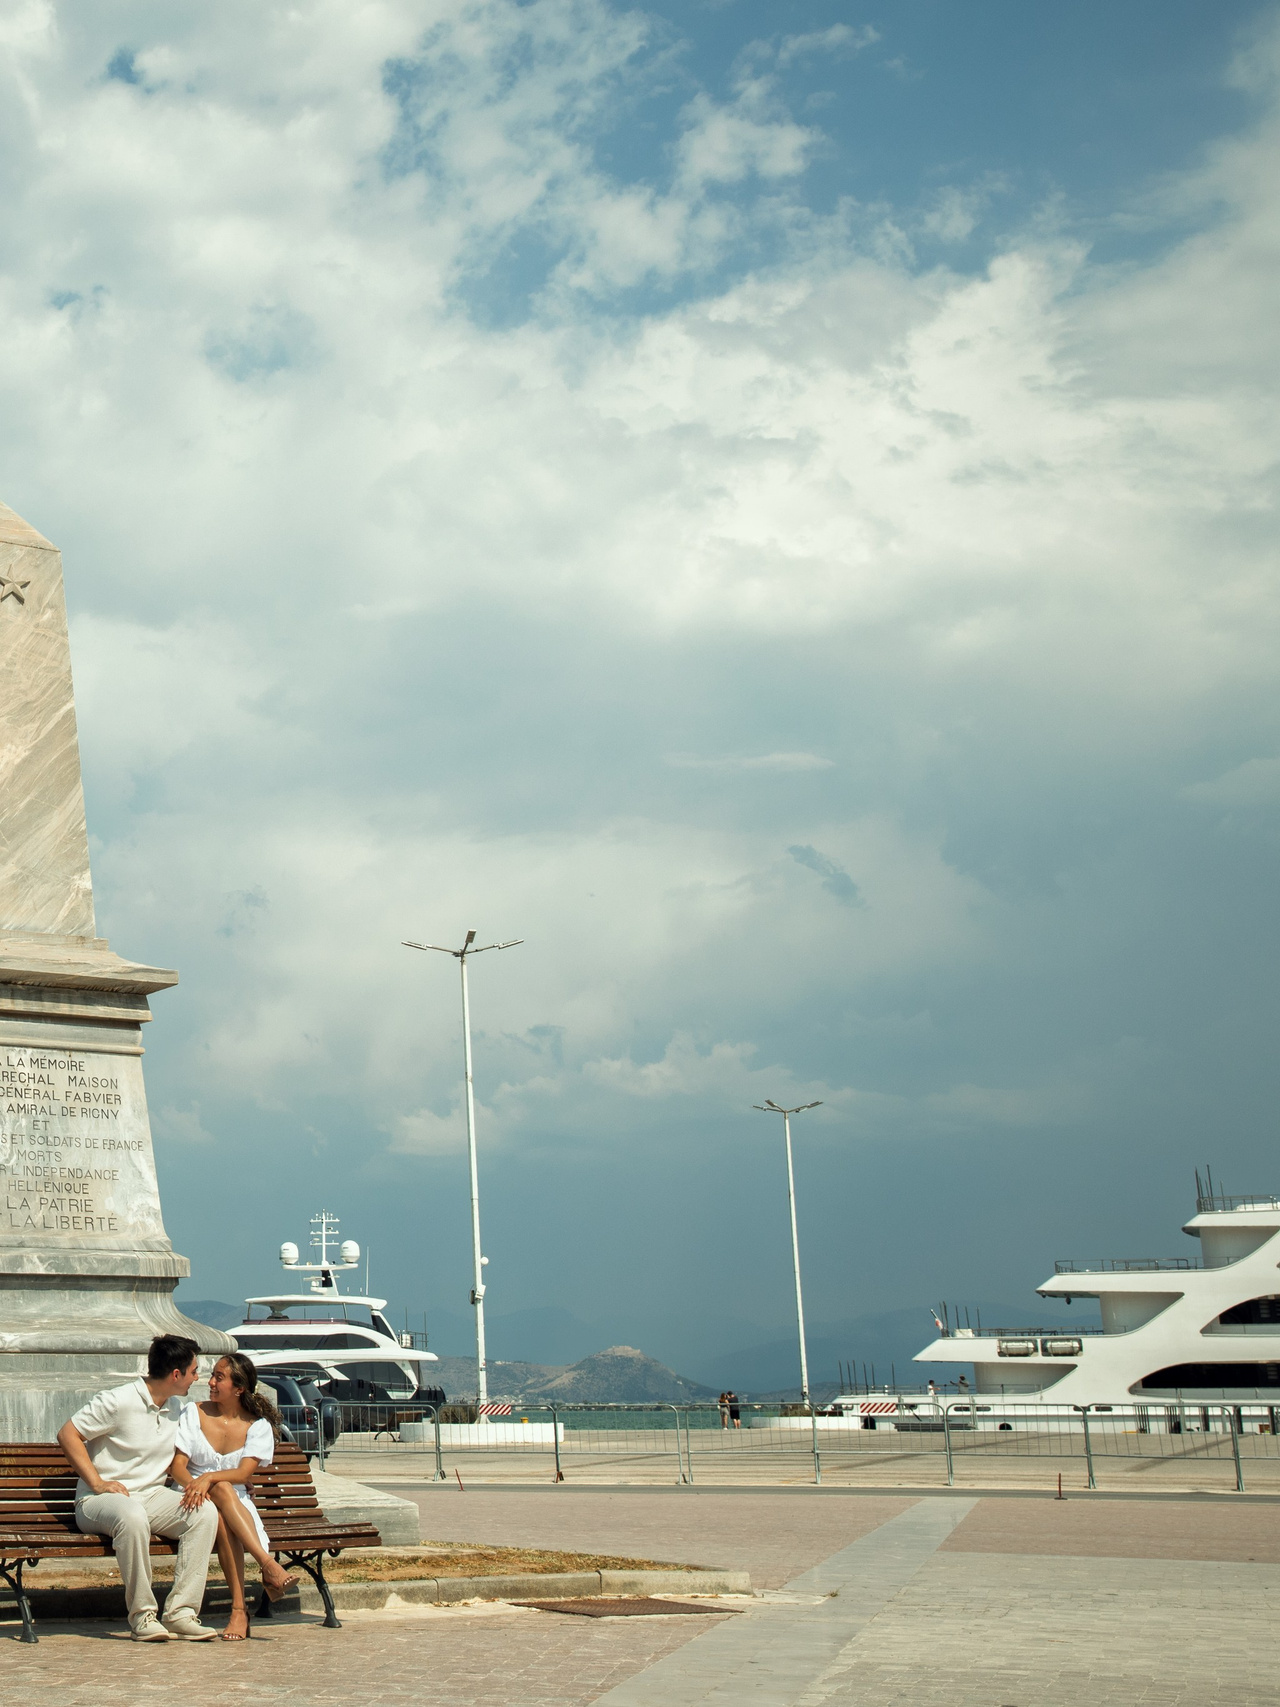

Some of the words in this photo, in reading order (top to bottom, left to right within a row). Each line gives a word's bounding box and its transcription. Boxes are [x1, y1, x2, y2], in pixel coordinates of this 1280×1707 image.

[6, 1055, 25, 1068] LA
[30, 1055, 85, 1071] MÉMOIRE
[68, 1075, 118, 1089] MAISON
[65, 1091, 121, 1105] FABVIER
[61, 1106, 76, 1117] DE
[81, 1107, 119, 1120] RIGNY
[33, 1120, 50, 1131] ET
[11, 1134, 25, 1145] ET
[29, 1135, 81, 1148] SOLDATS
[85, 1138, 99, 1149] DE
[102, 1139, 144, 1151] FRANCE
[17, 1149, 62, 1162] MORTS
[8, 1178, 89, 1194] HELLÉNIQUE
[6, 1195, 30, 1210] LA
[40, 1197, 94, 1213] PATRIE
[10, 1213, 36, 1228] LA
[43, 1213, 118, 1231] LIBERTÉ
